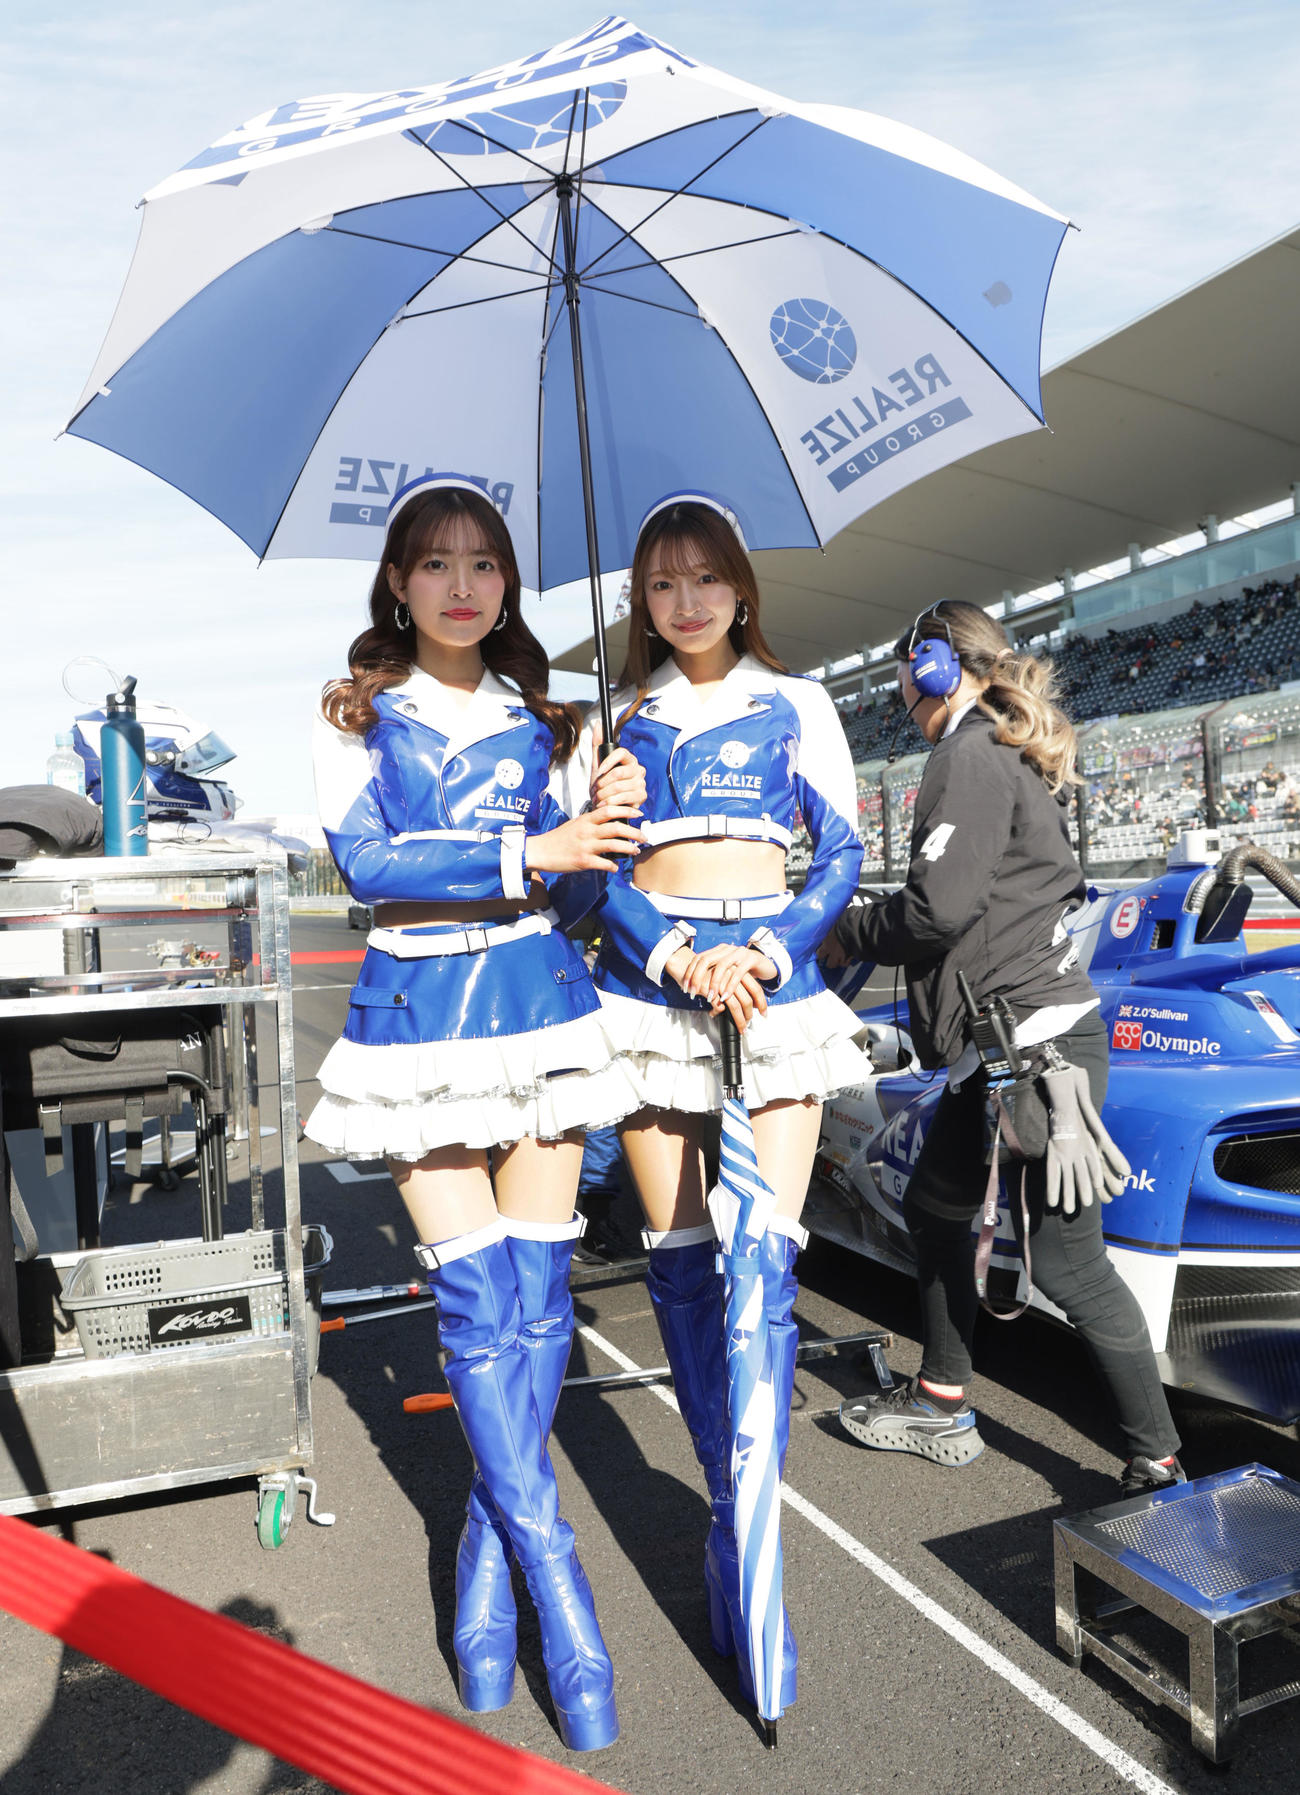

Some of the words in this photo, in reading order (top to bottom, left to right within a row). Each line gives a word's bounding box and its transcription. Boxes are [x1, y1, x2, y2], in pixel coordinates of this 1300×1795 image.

[238, 44, 619, 156] GROUP
[701, 772, 762, 789] REALIZE
[920, 823, 957, 862] 4
[1117, 903, 1134, 928] E
[1142, 1030, 1221, 1056] Olympic
